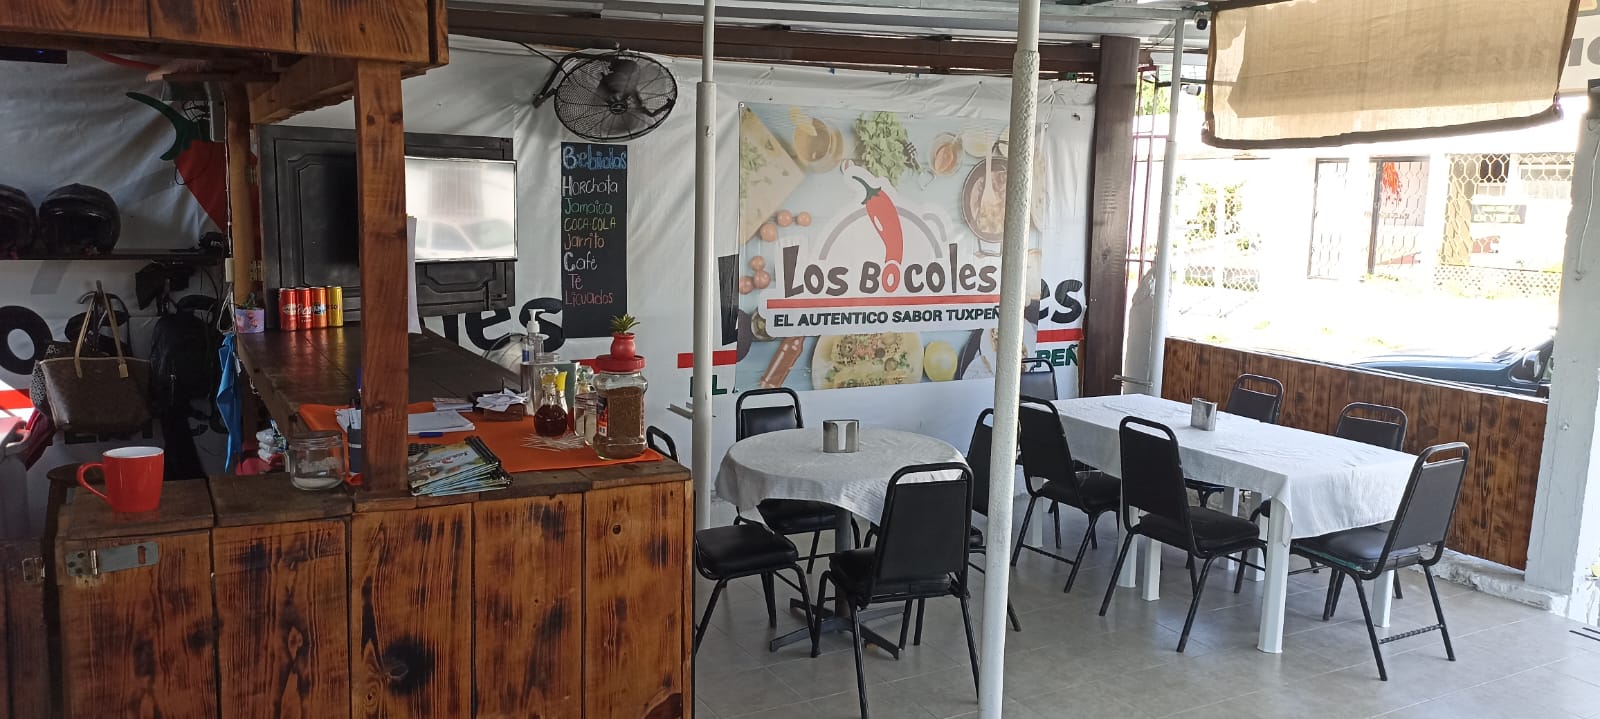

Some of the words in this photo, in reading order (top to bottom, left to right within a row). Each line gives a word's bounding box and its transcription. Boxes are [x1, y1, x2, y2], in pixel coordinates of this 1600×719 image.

[562, 144, 627, 170] Bebidas
[563, 198, 613, 215] Jamaica
[564, 232, 605, 250] Jarrito
[563, 251, 598, 271] Café
[782, 245, 849, 299] Los
[568, 273, 584, 290] Té
[565, 290, 614, 307] Licuados
[773, 314, 794, 328] EL
[797, 311, 889, 326] AUTENTICO
[892, 309, 943, 324] SABOR
